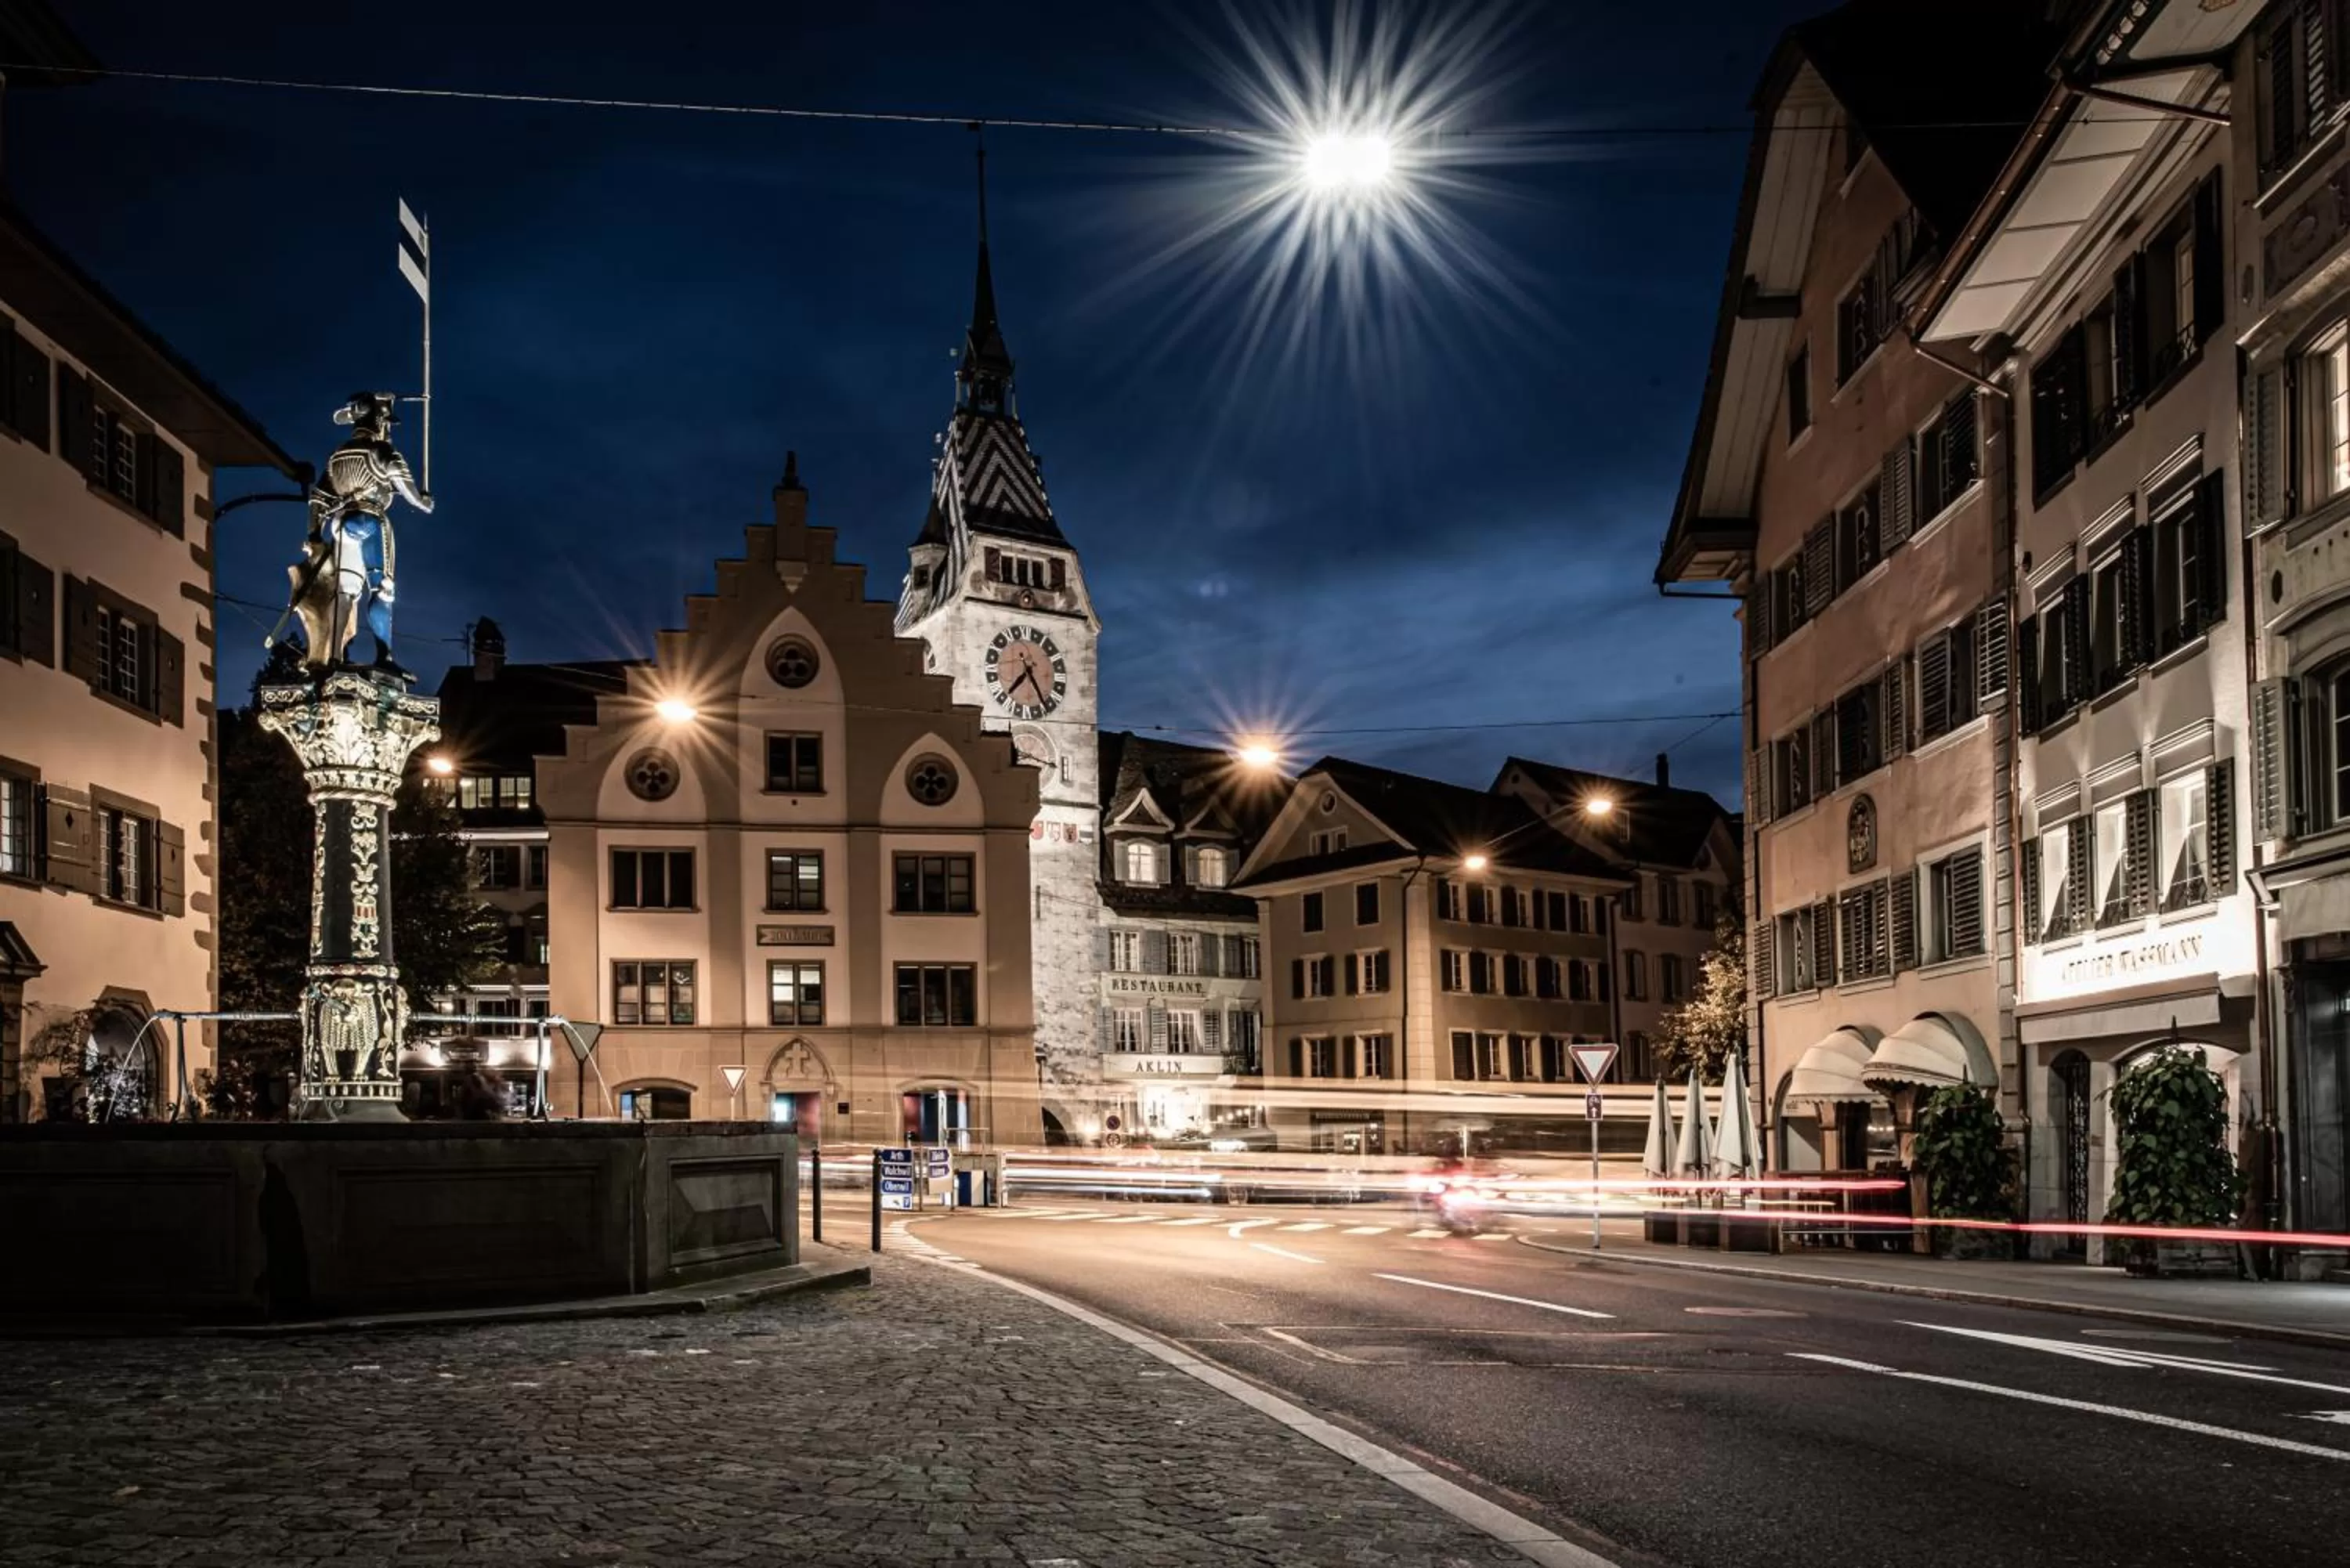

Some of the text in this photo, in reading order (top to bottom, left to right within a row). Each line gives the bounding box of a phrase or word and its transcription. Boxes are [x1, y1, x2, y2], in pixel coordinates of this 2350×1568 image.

[1054, 673, 1066, 683] III
[1112, 978, 1203, 994] RESTAURANT
[1135, 1060, 1183, 1073] AKLIN
[890, 1151, 905, 1161] Arth
[884, 1180, 909, 1191] Oberwil
